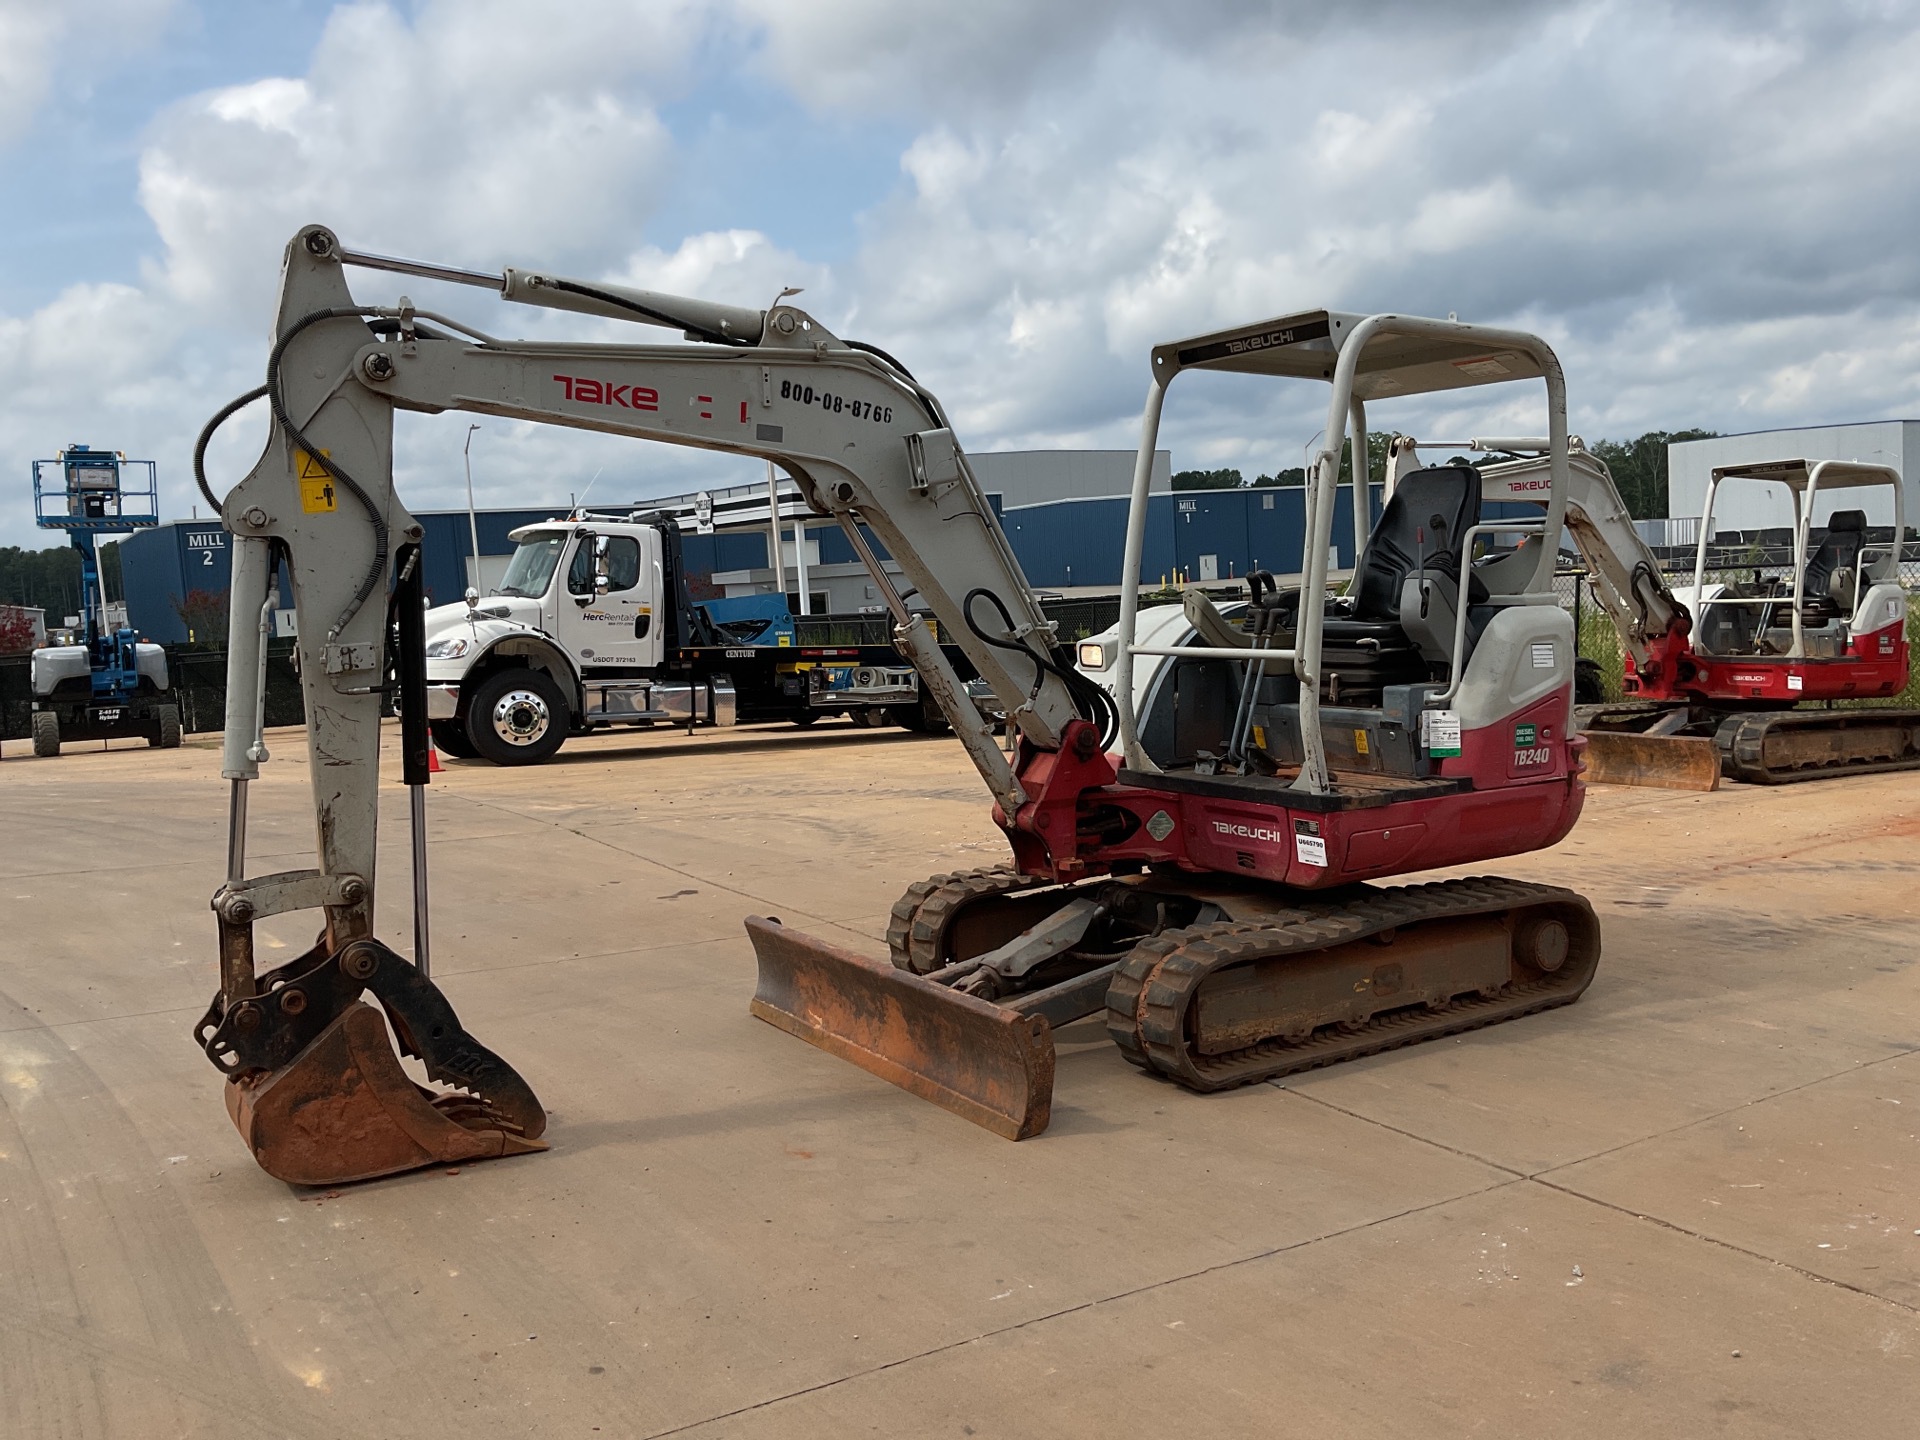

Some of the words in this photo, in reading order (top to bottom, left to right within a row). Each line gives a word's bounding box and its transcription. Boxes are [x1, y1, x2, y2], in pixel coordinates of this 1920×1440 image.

[780, 379, 893, 424] 800-08-8766
[1179, 501, 1197, 510] MILL
[1185, 512, 1190, 523] 1
[189, 534, 224, 547] MILL
[203, 550, 213, 566] 2
[725, 649, 756, 658] CENTURY
[1514, 747, 1550, 766] TB240
